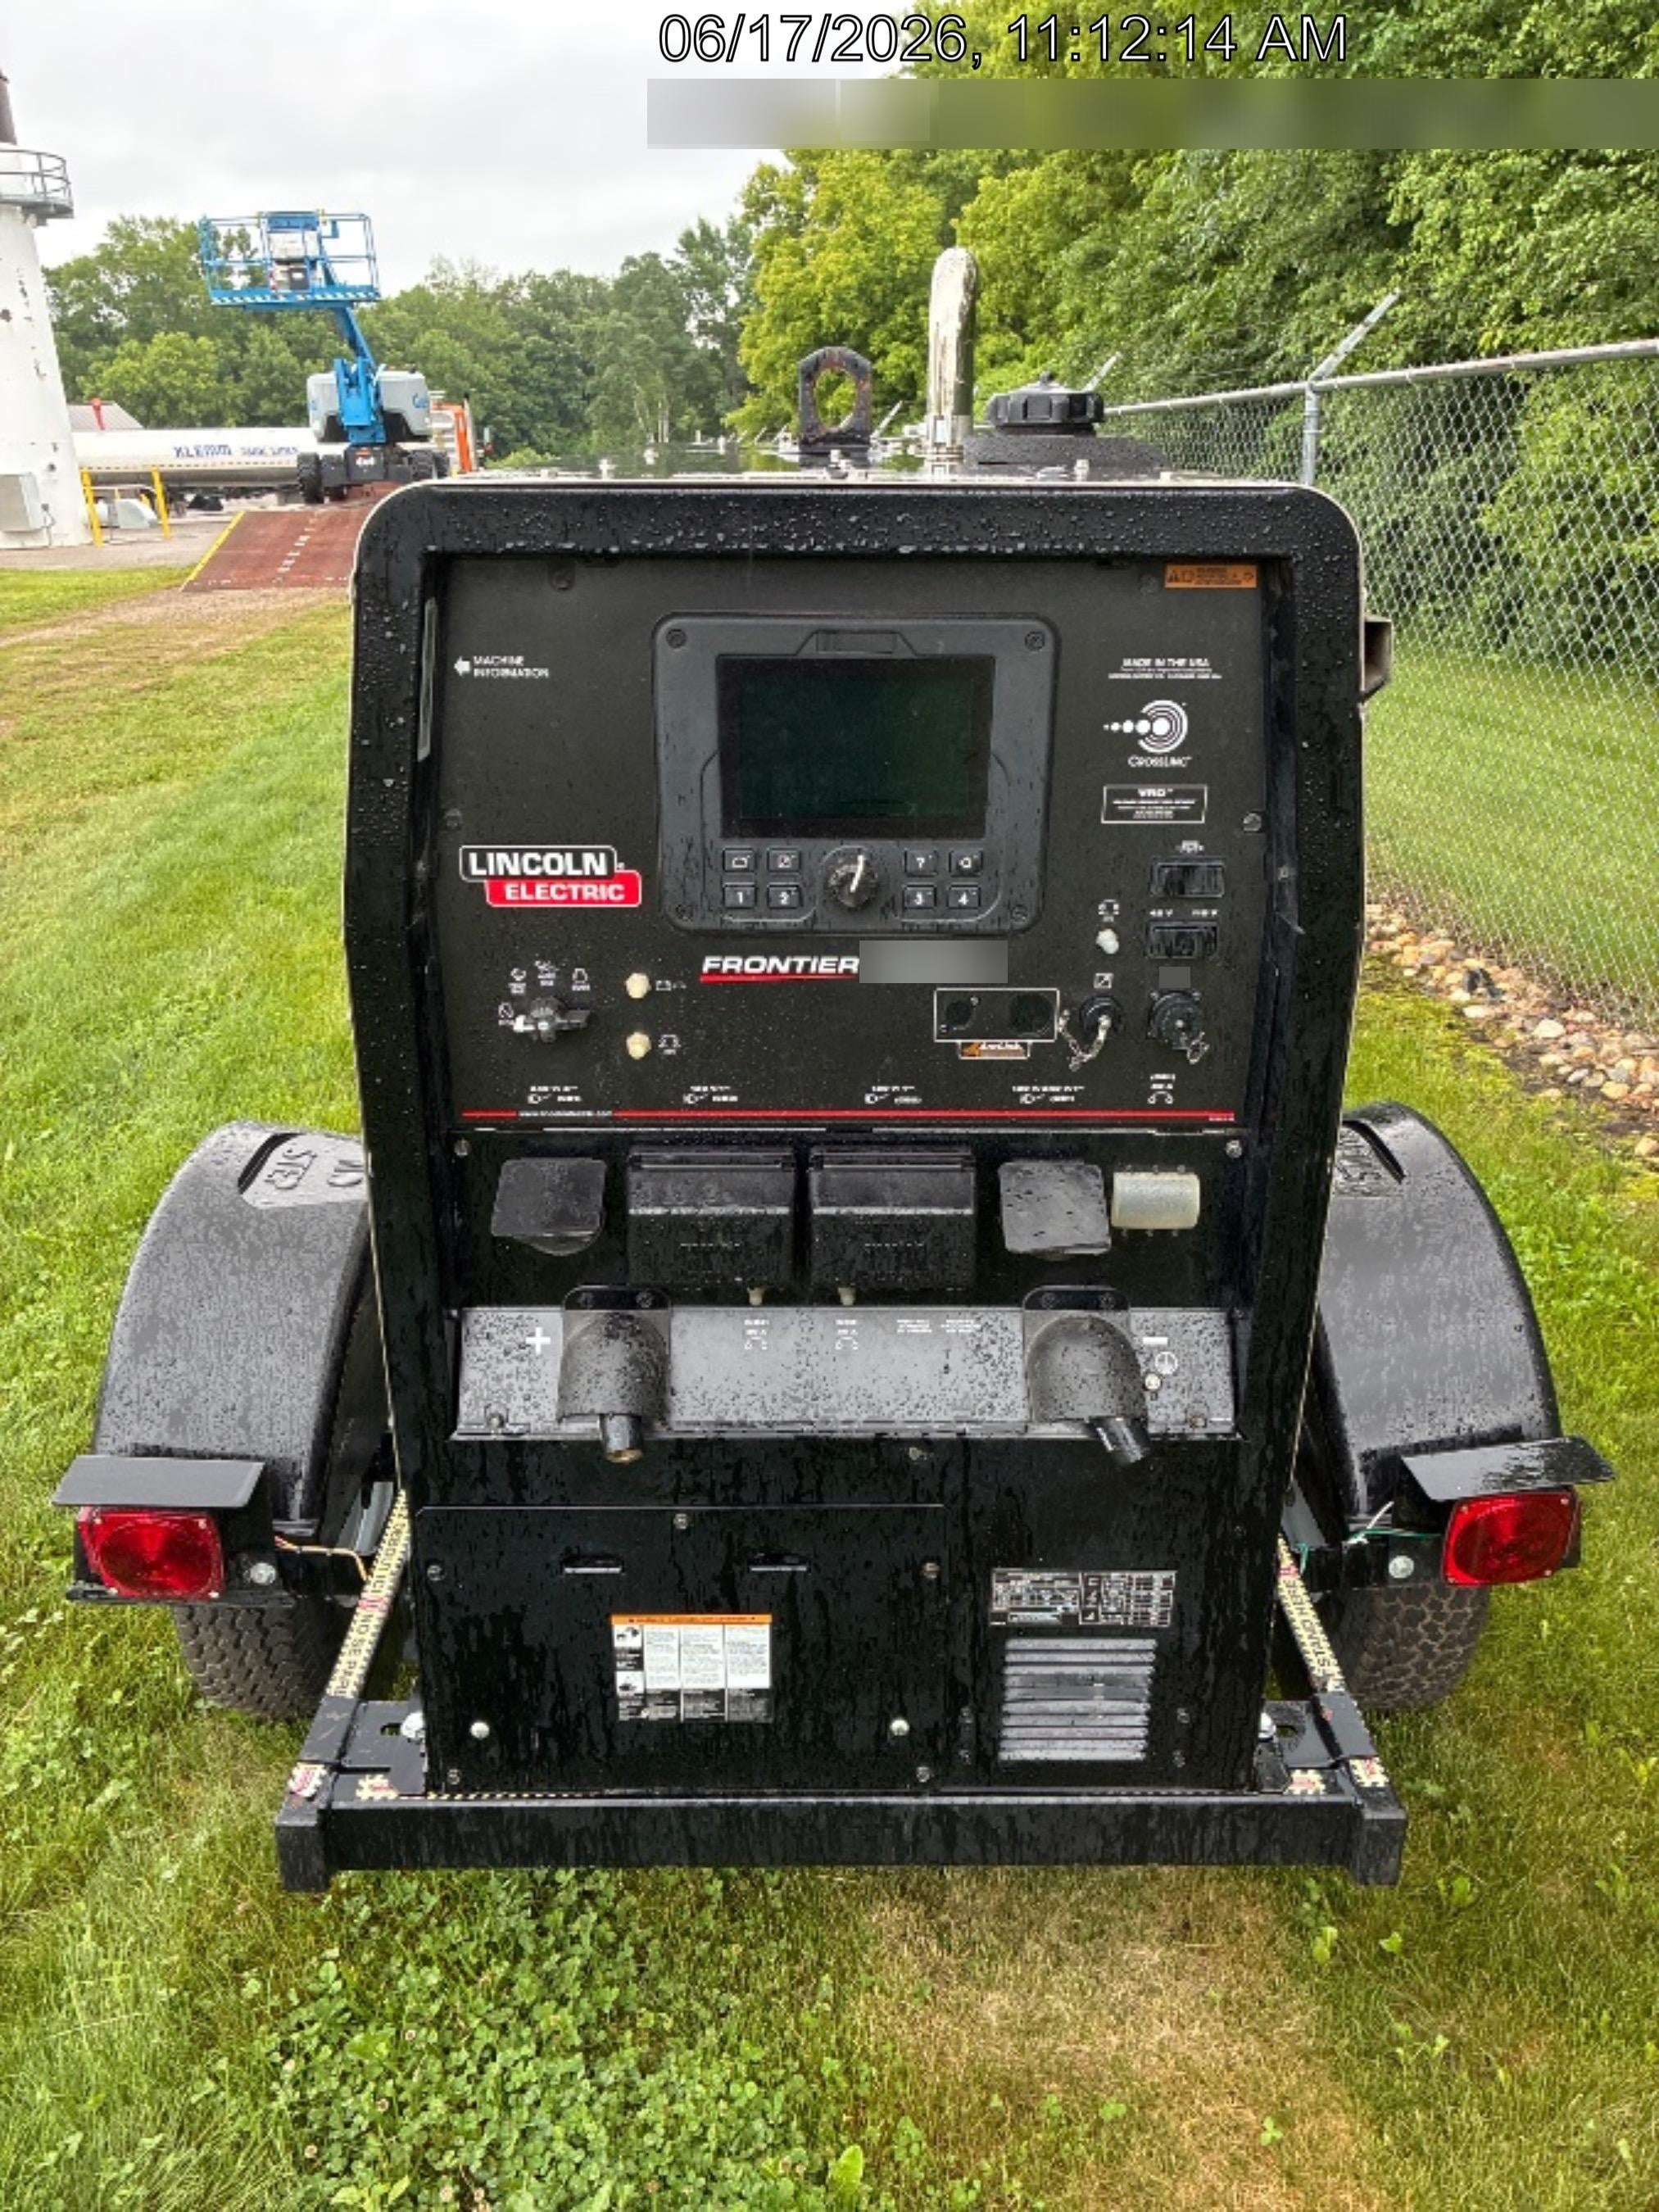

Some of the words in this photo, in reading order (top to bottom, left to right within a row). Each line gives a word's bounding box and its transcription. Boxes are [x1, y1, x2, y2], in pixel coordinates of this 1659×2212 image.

[474, 655, 524, 666] MACHINE
[1154, 658, 1165, 667] IN
[1167, 658, 1187, 667] THE
[474, 668, 549, 678] INFORMATION
[468, 852, 608, 876] LINCOLN
[505, 883, 625, 900] ELECTRIC
[737, 891, 743, 904] 1
[779, 891, 790, 905] 2
[958, 891, 969, 905] 4
[702, 956, 859, 974] FRONTIER
